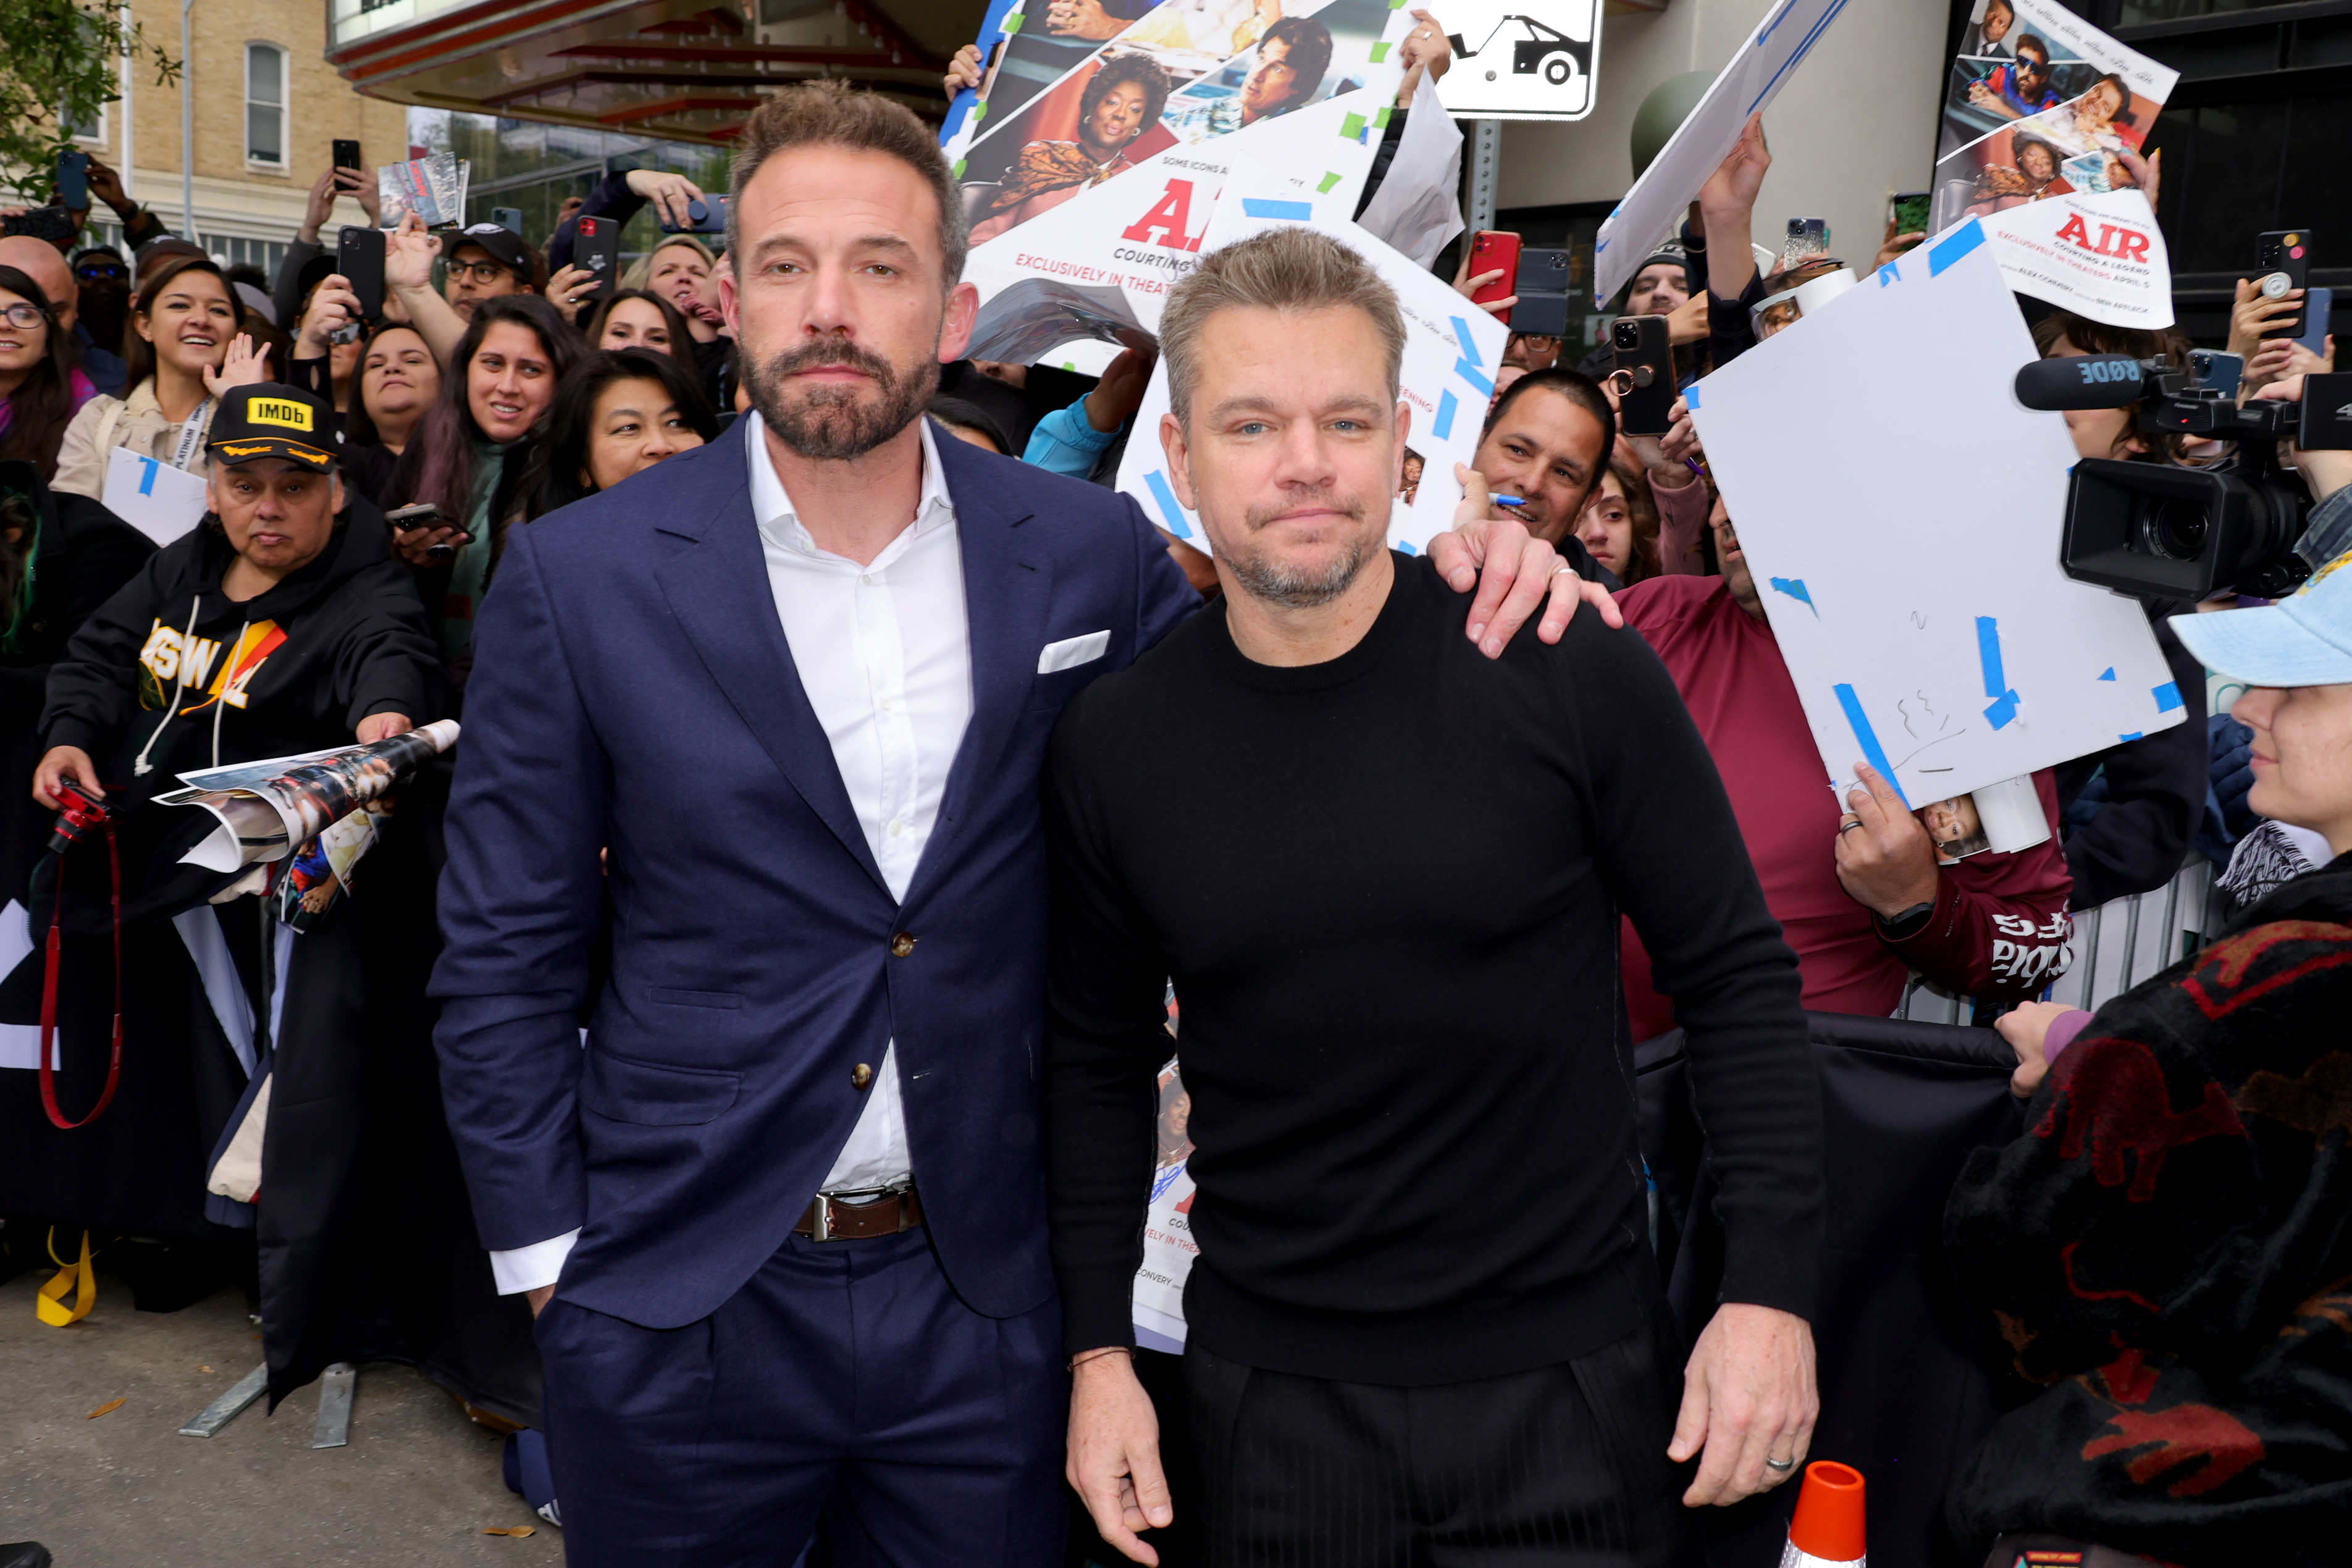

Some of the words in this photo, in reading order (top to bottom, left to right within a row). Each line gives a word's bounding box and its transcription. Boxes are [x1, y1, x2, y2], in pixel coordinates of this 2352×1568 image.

[1162, 156, 1188, 168] SOME
[1190, 161, 1219, 174] ICONS
[2056, 212, 2150, 264] AIR
[1114, 247, 1193, 272] COURTING
[1997, 230, 2056, 257] EXCLUSIVELY
[2067, 258, 2112, 280] THEATERS
[2113, 275, 2141, 286] APRIL
[2054, 241, 2100, 264] COURTING
[2110, 262, 2151, 275] LEGEND
[1015, 253, 1106, 285] EXCLUSIVELY
[1107, 272, 1125, 286] IN
[1128, 275, 1172, 296] THEAT
[258, 403, 304, 424] IMDb
[1399, 385, 1434, 413] EENING
[174, 429, 196, 469] PLATINUM
[1166, 1235, 1175, 1246] IN
[1177, 1238, 1201, 1254] THEA
